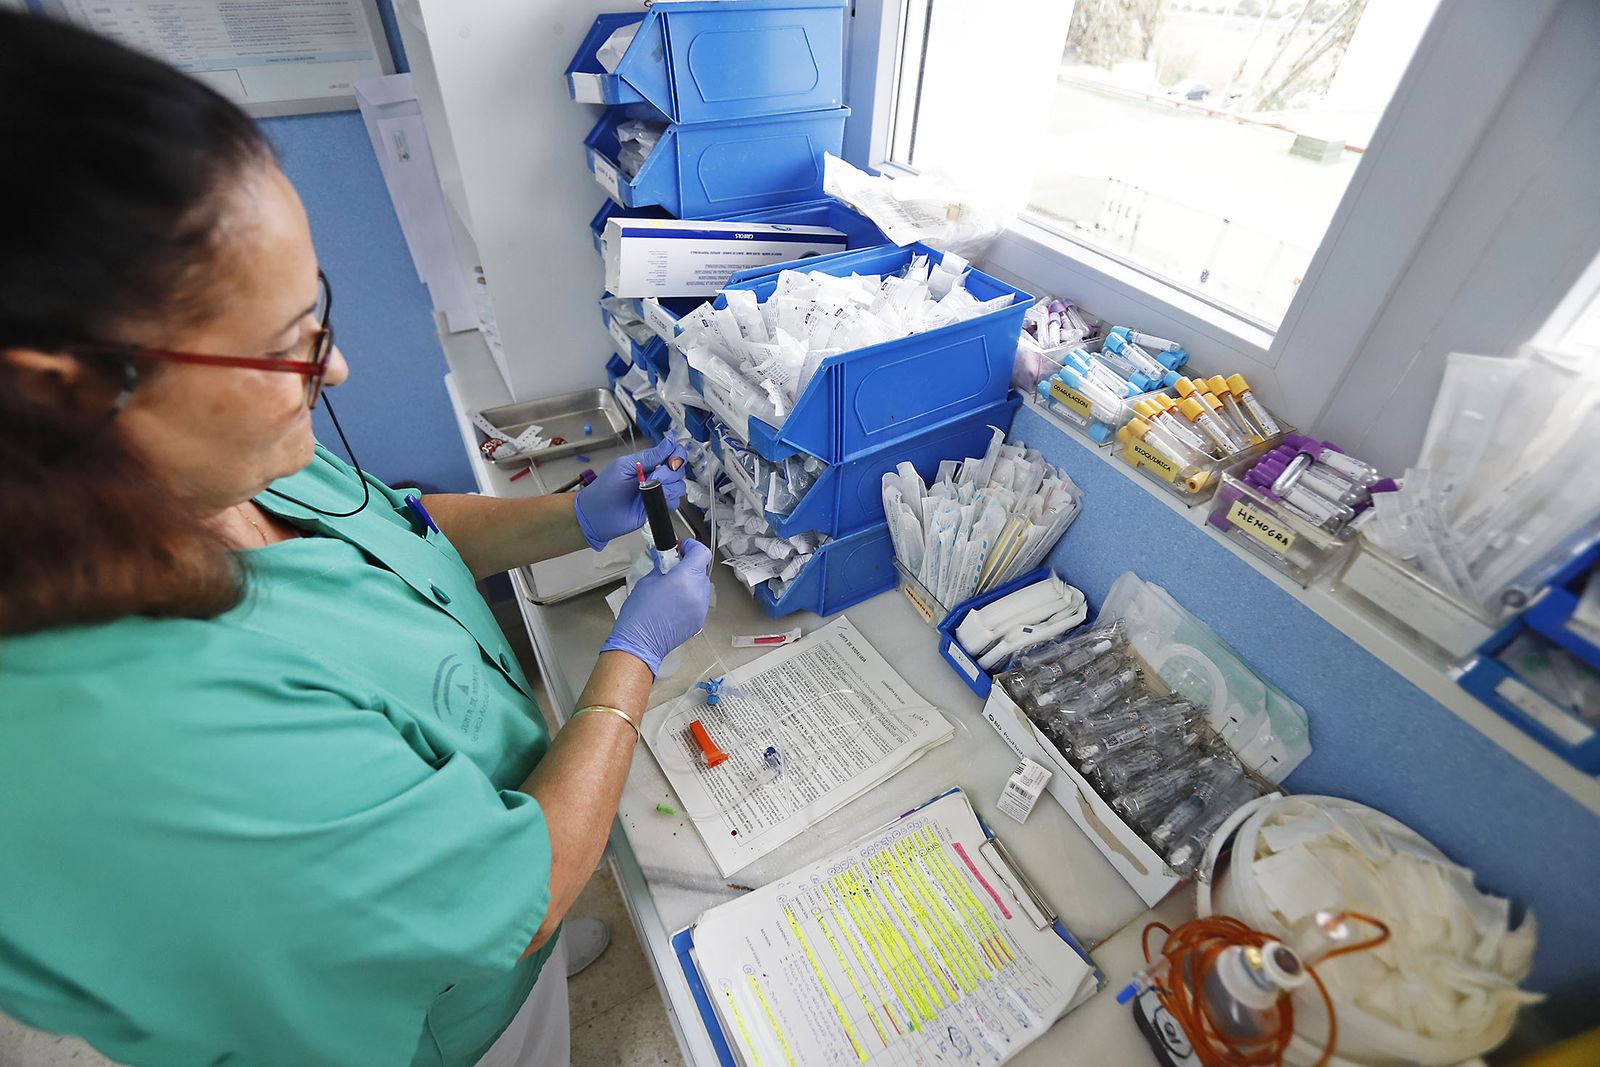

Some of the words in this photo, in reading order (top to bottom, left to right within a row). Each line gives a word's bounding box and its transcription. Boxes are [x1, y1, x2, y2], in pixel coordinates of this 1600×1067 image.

[1053, 383, 1089, 409] COAGULACION
[1133, 445, 1172, 473] BIOQUIMICA
[1237, 507, 1290, 547] HEMOGRA
